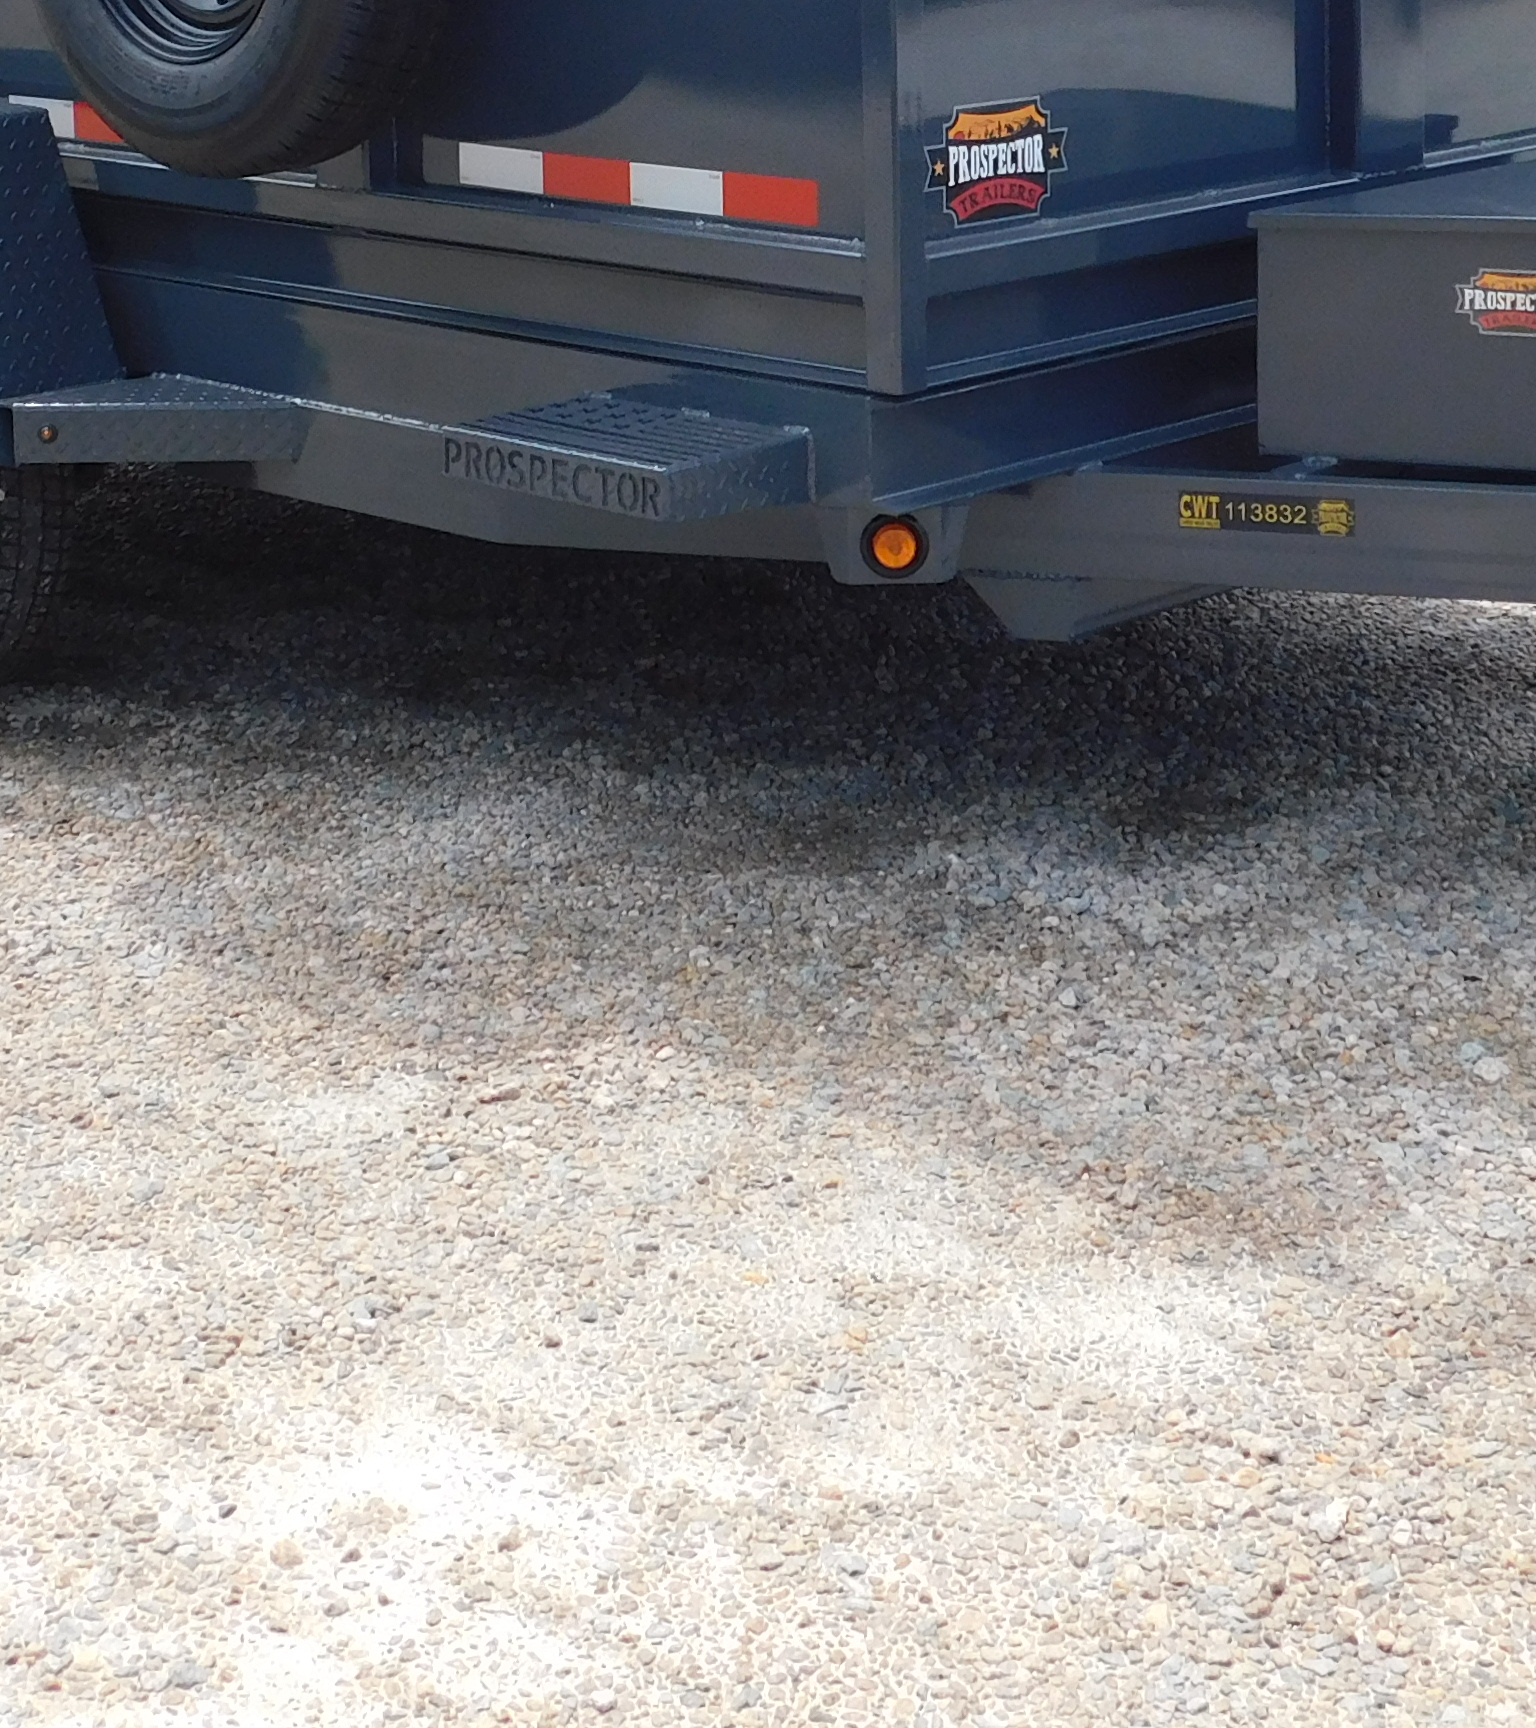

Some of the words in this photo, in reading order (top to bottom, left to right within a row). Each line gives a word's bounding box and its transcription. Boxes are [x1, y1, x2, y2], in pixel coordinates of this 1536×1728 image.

[948, 133, 1046, 187] PROSPECTOR
[958, 181, 1037, 214] TRAILERS
[443, 437, 662, 517] PROSPECTOR
[1179, 494, 1221, 520] CWT
[1225, 501, 1307, 525] 113832
